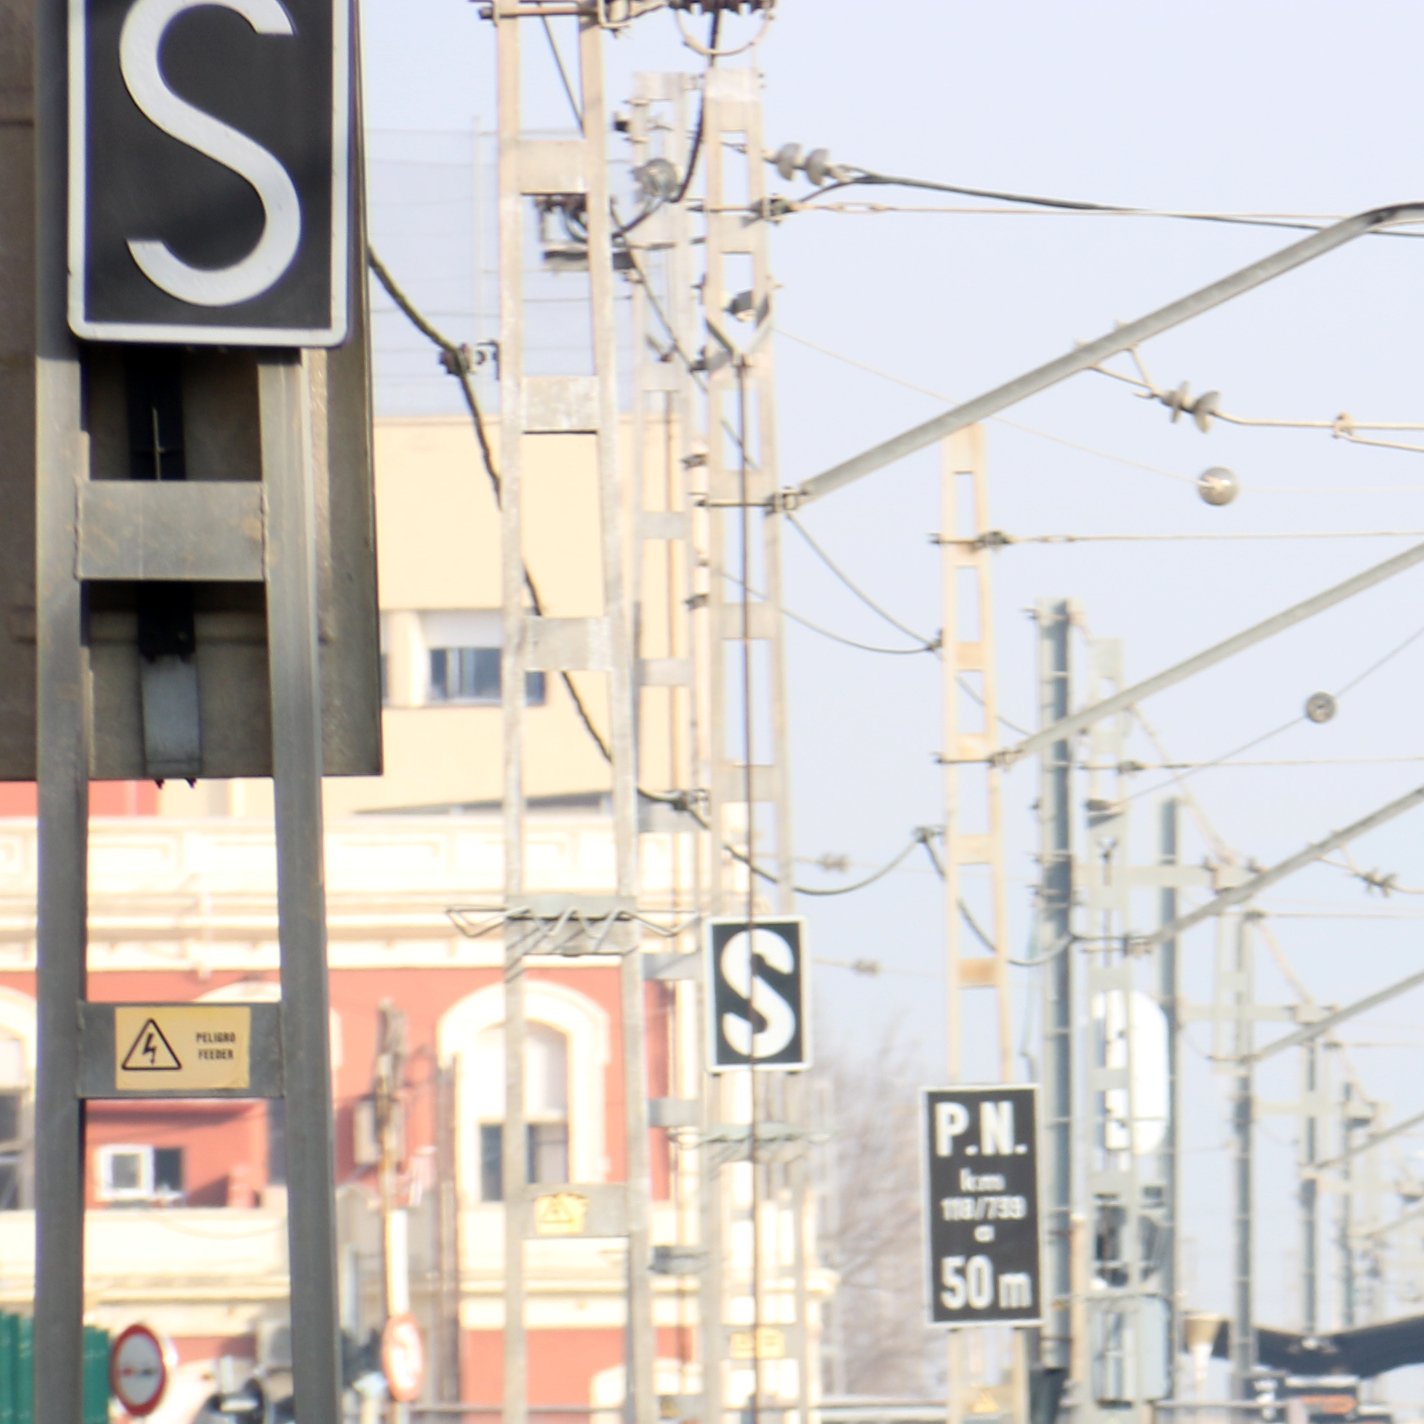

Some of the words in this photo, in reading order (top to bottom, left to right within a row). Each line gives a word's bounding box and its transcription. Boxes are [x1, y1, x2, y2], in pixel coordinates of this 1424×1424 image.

[119, 0, 301, 307] S
[720, 928, 796, 1059] S
[195, 1031, 236, 1043] PELIGRO
[198, 1049, 234, 1060] FEEDER
[935, 1100, 1029, 1157] P.N.
[959, 1168, 1006, 1191] km
[941, 1254, 994, 1310] 50
[999, 1272, 1032, 1309] m
